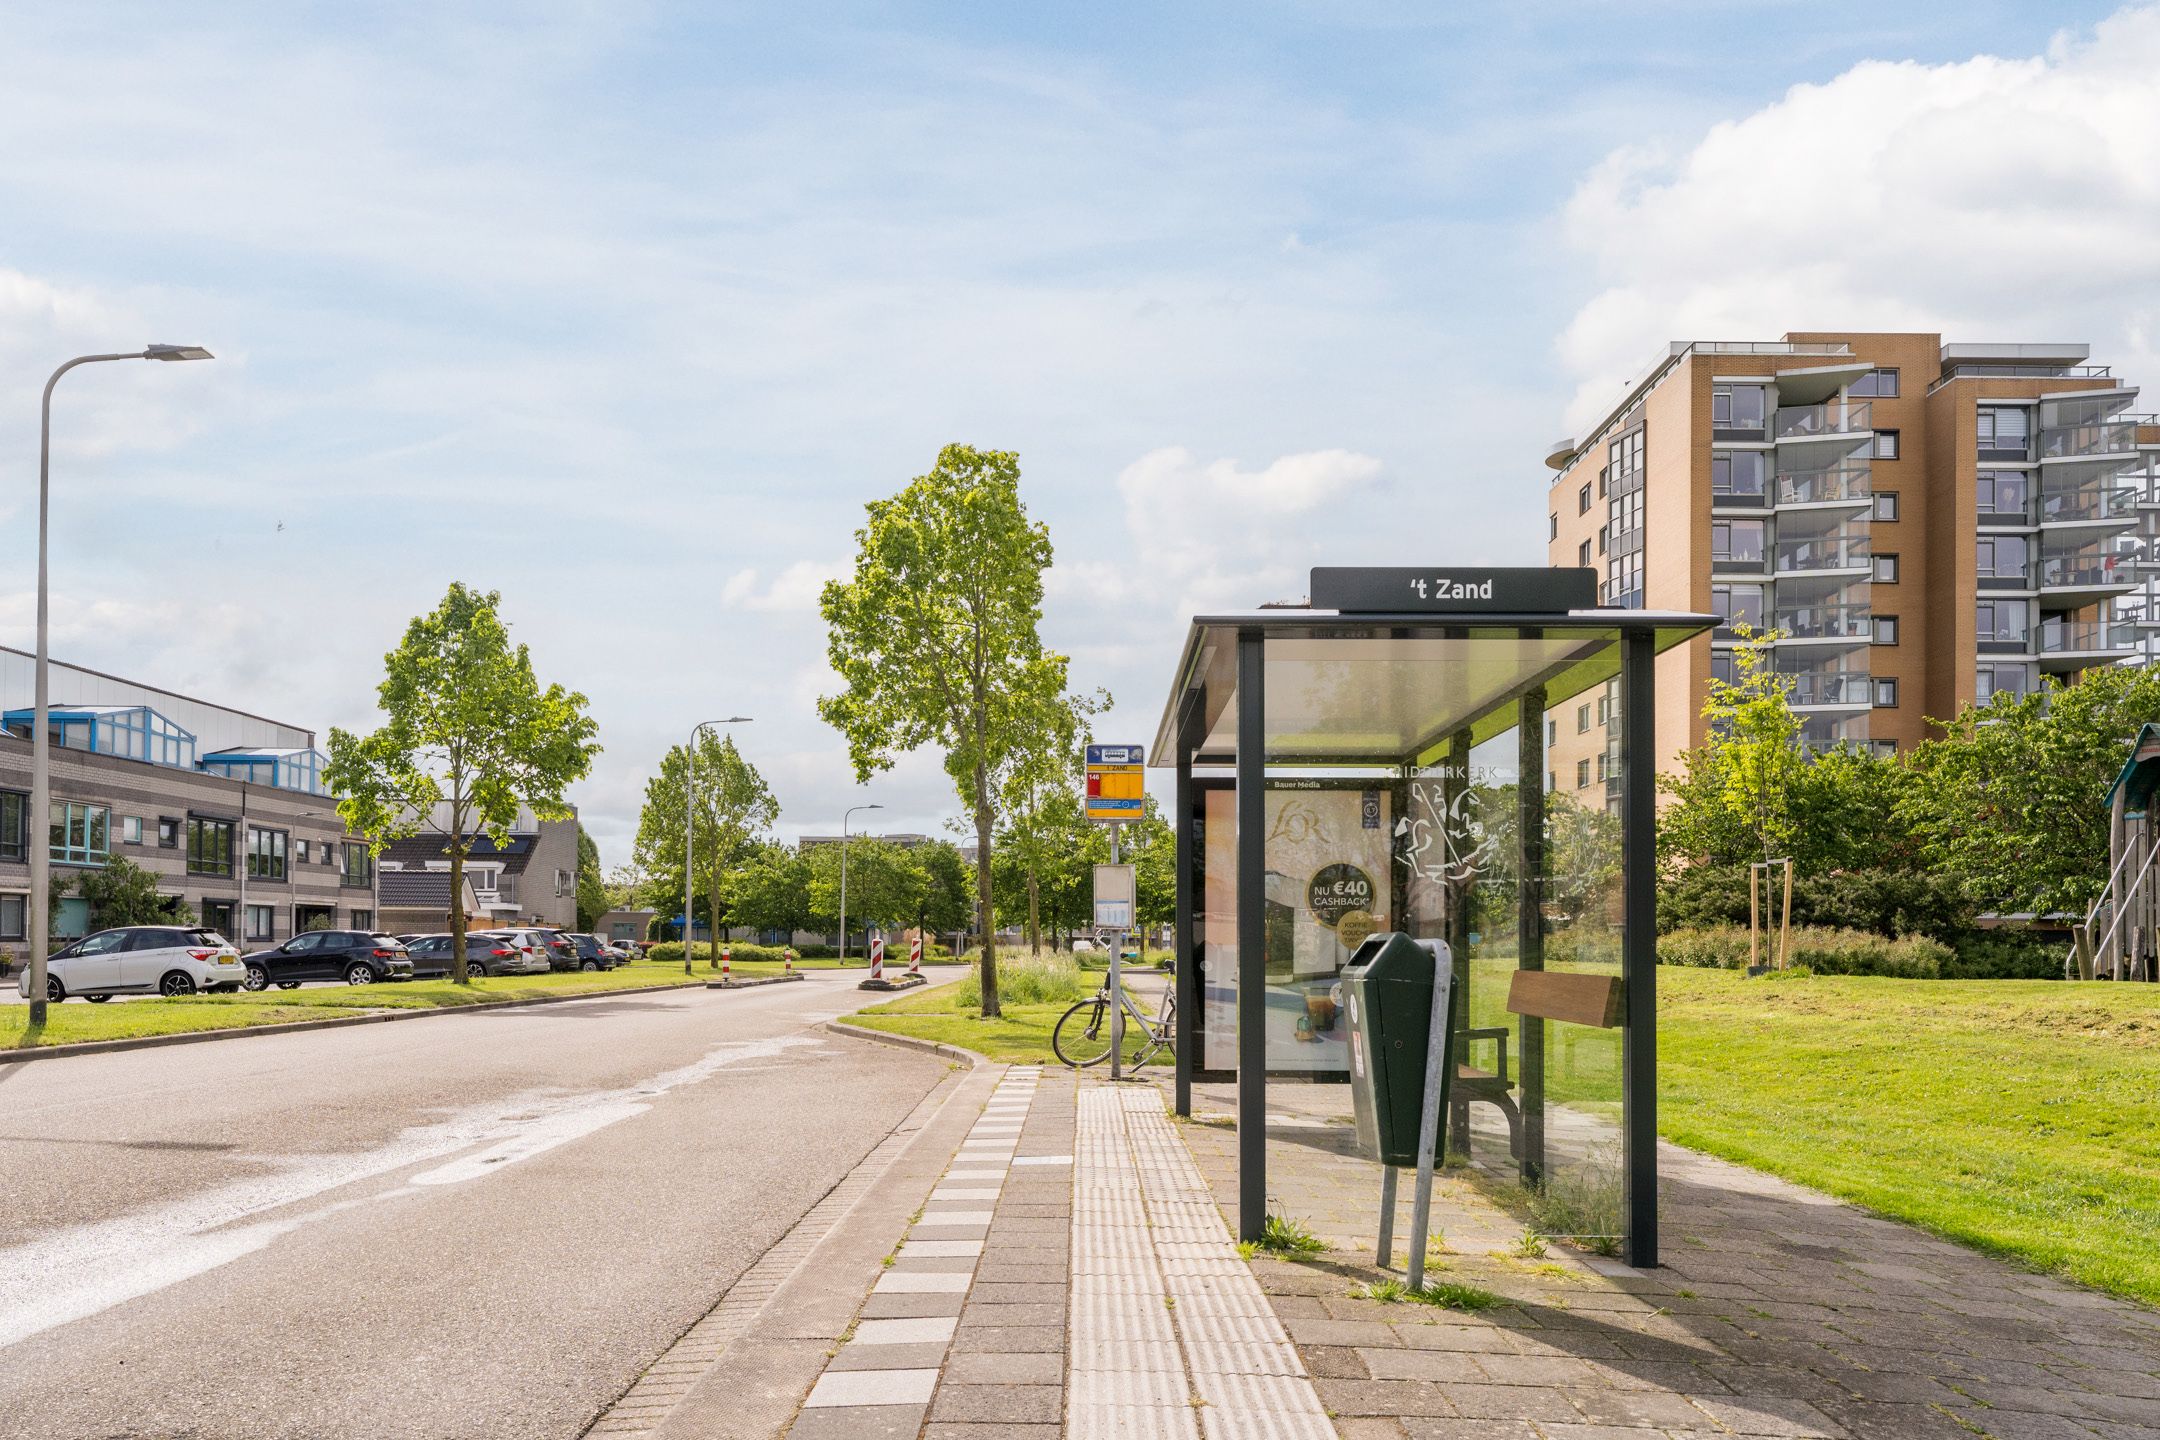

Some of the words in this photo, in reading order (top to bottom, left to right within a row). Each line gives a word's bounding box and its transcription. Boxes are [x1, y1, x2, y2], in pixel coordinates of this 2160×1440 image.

[1435, 578, 1493, 599] Zand
[1391, 766, 1498, 779] RIDDERKERK
[1314, 886, 1330, 896] NU
[1333, 880, 1368, 896] €40
